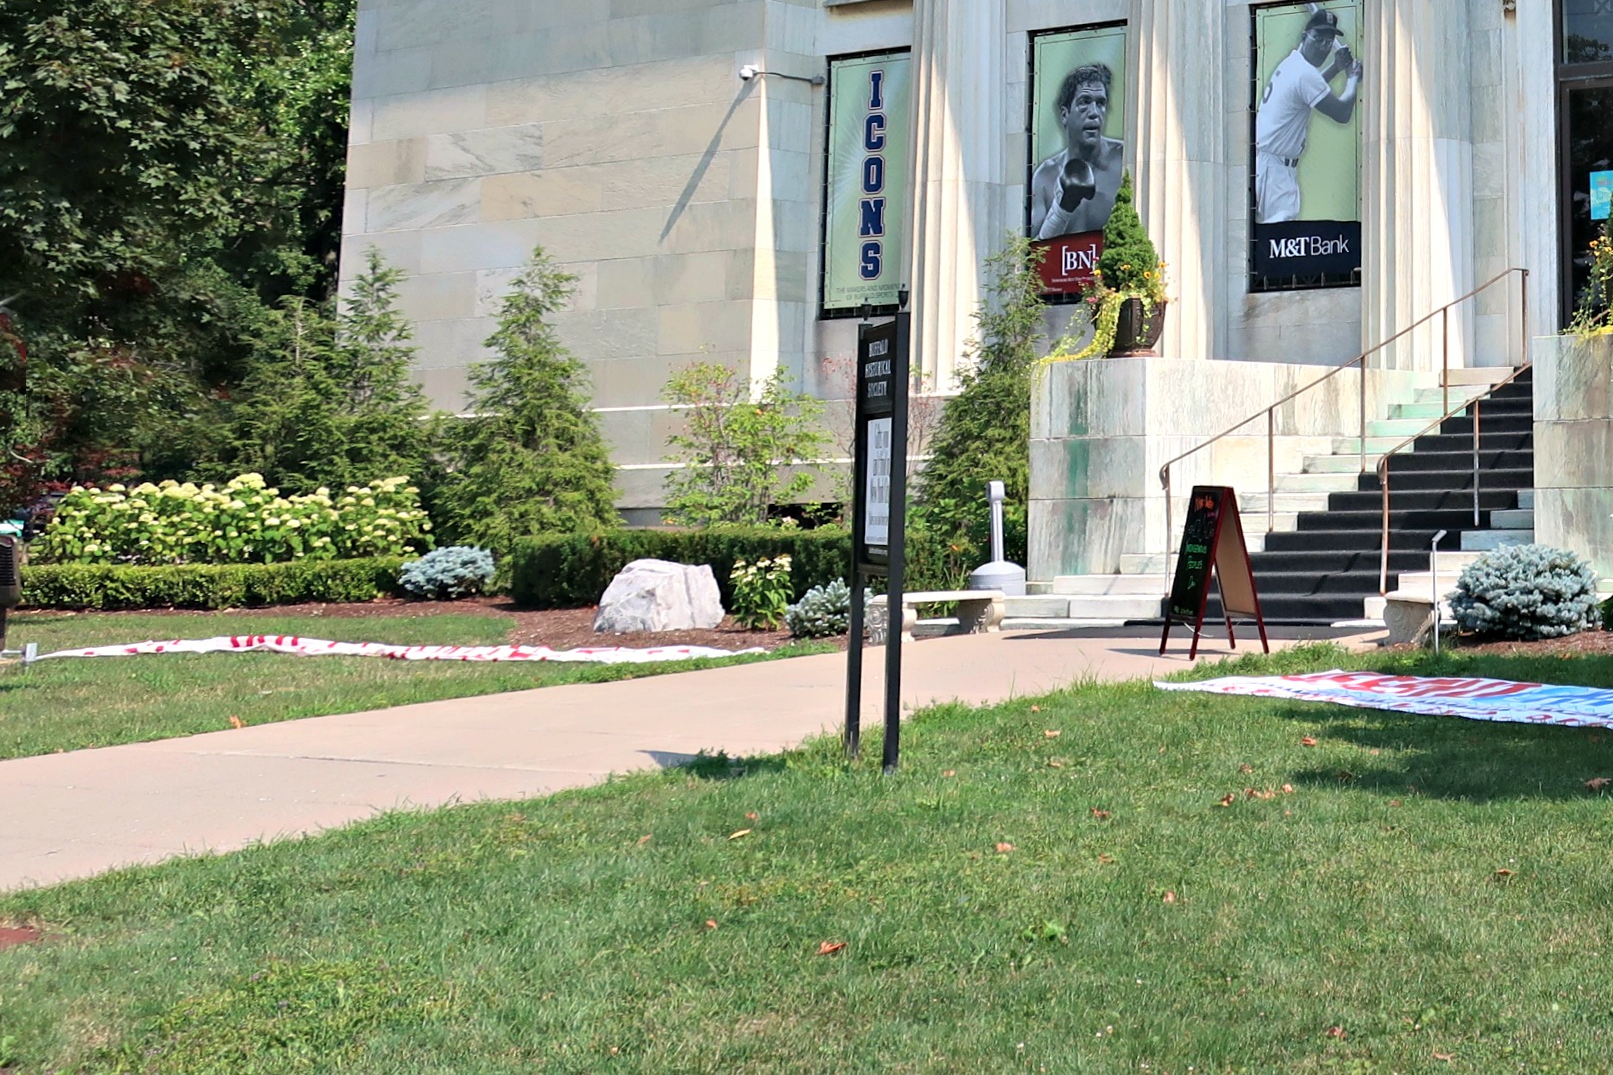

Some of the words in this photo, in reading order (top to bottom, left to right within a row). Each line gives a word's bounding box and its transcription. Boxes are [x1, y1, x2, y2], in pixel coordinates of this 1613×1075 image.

[859, 70, 887, 281] ICONS
[1268, 236, 1310, 259] M&T
[1310, 233, 1350, 256] Bank
